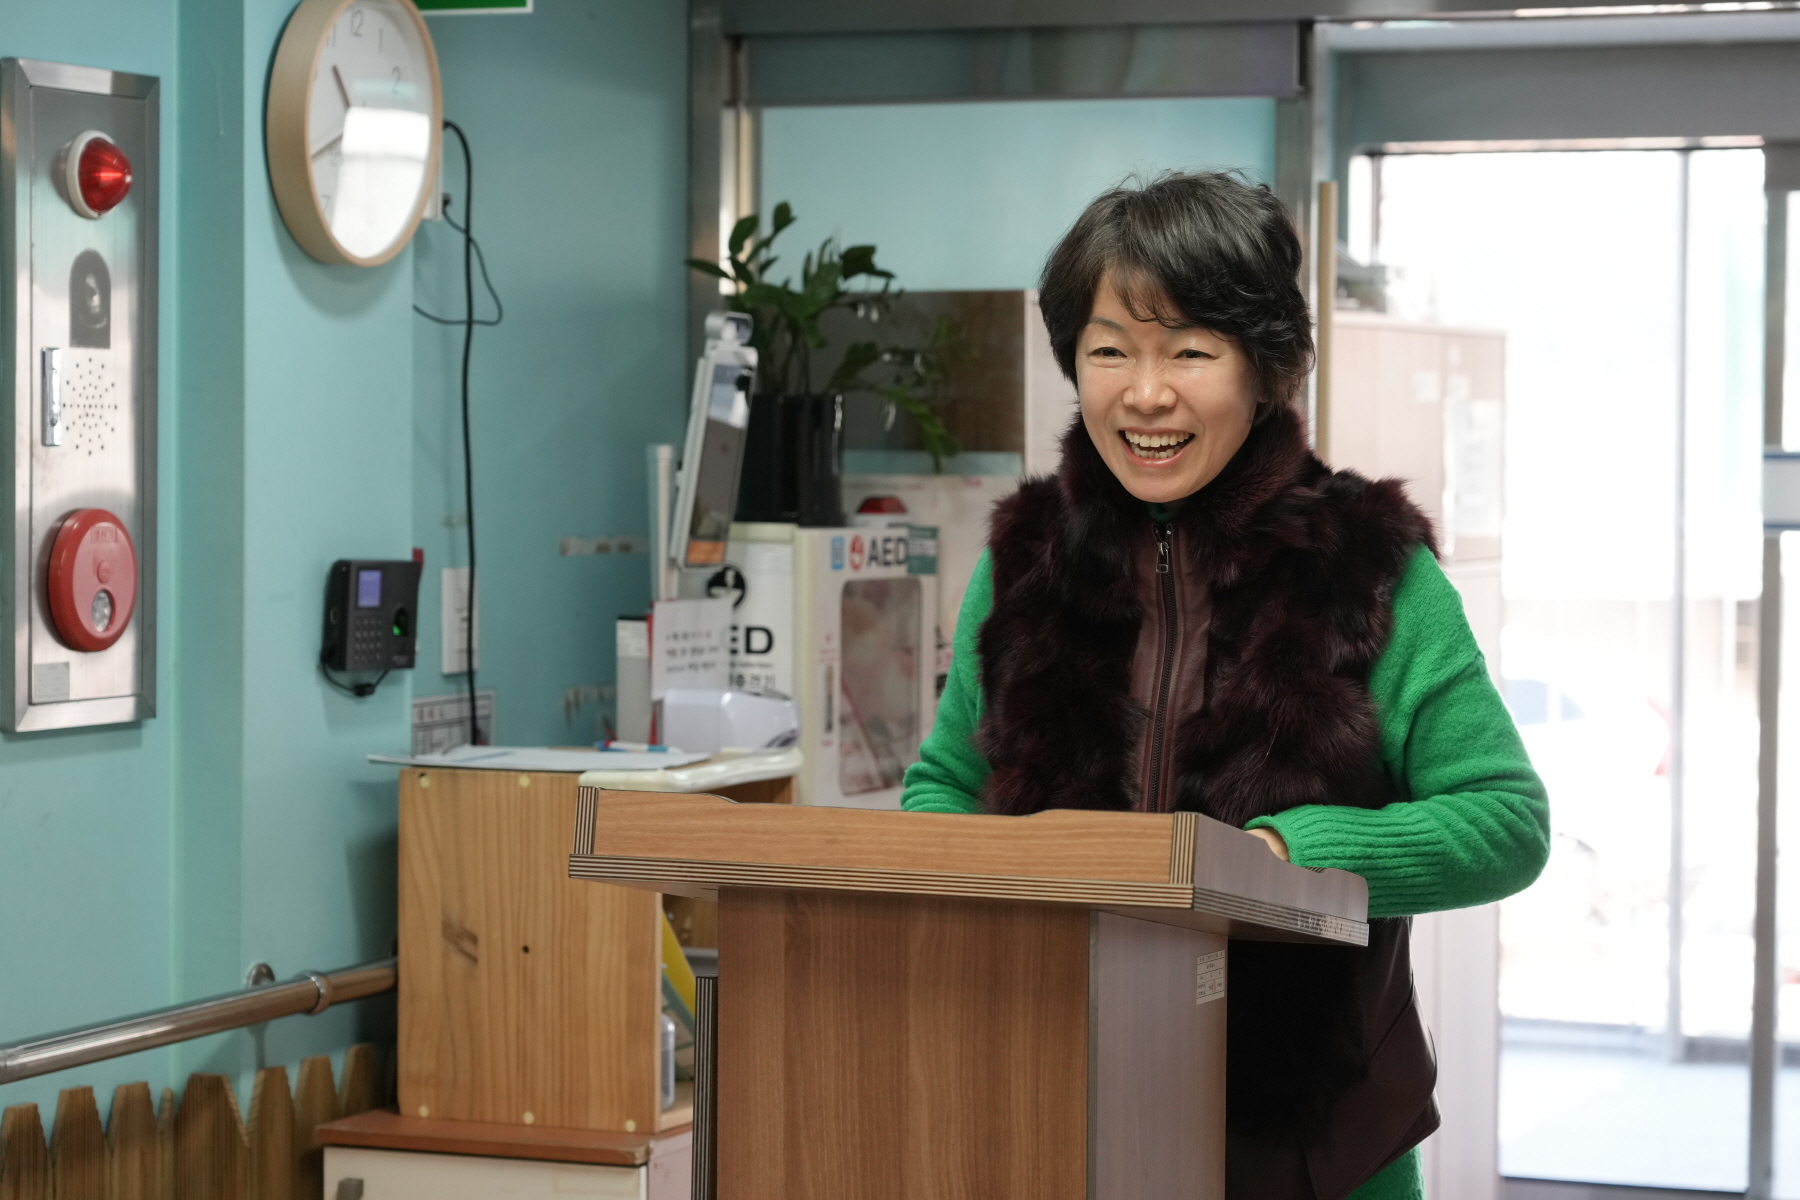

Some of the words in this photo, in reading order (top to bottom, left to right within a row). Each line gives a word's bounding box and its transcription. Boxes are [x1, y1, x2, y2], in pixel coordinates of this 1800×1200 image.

[350, 8, 364, 37] 12
[391, 66, 401, 94] 2
[867, 536, 908, 567] AED
